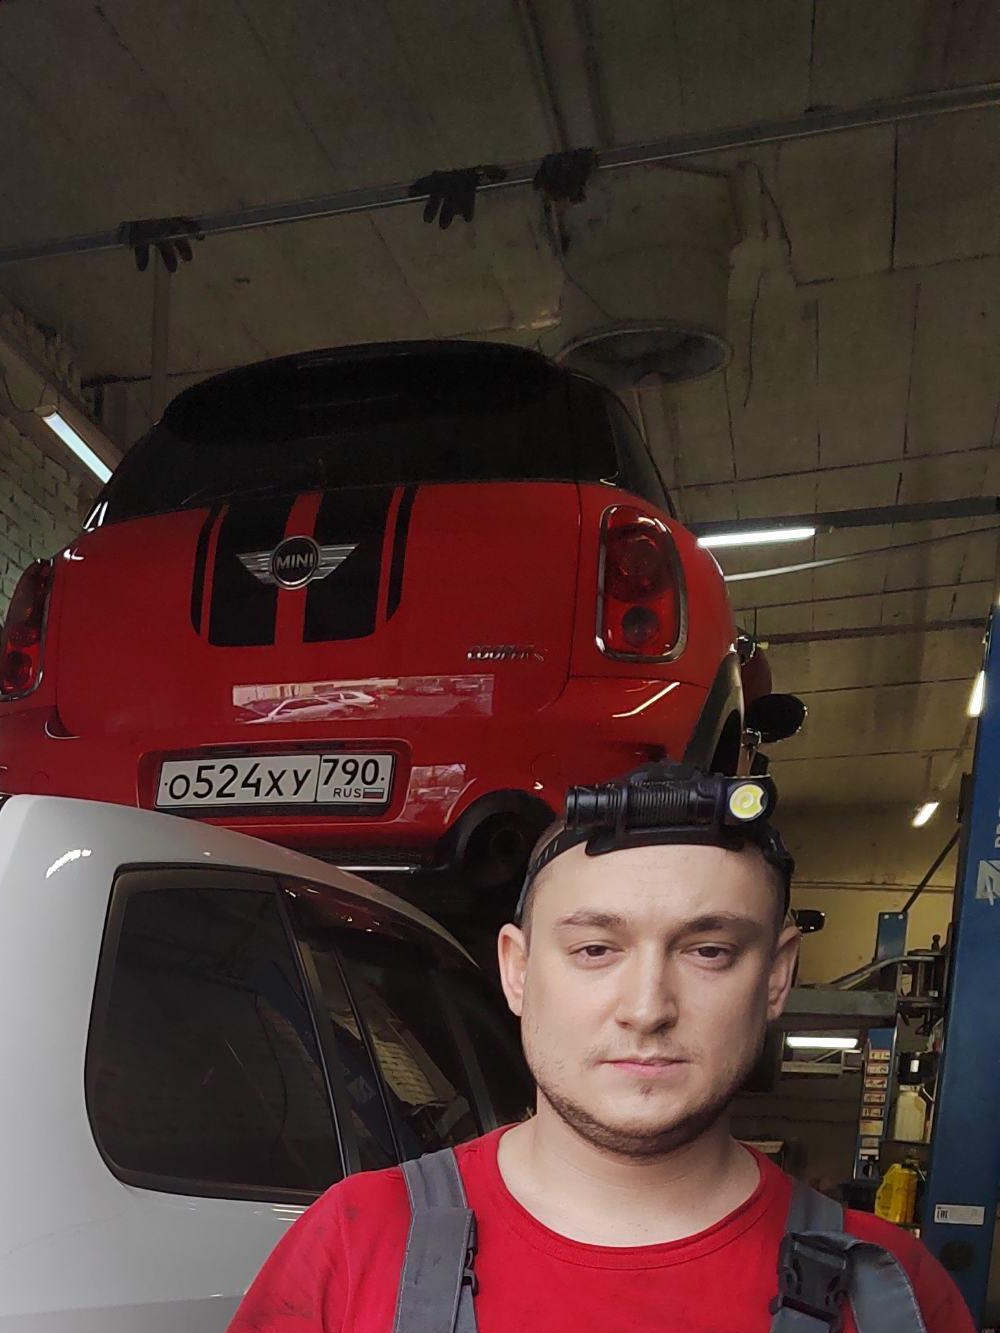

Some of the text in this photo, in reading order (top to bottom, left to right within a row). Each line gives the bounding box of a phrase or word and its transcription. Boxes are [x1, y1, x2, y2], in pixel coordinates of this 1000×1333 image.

[276, 552, 315, 571] MINI
[322, 758, 380, 786] 790
[333, 787, 362, 799] RUS
